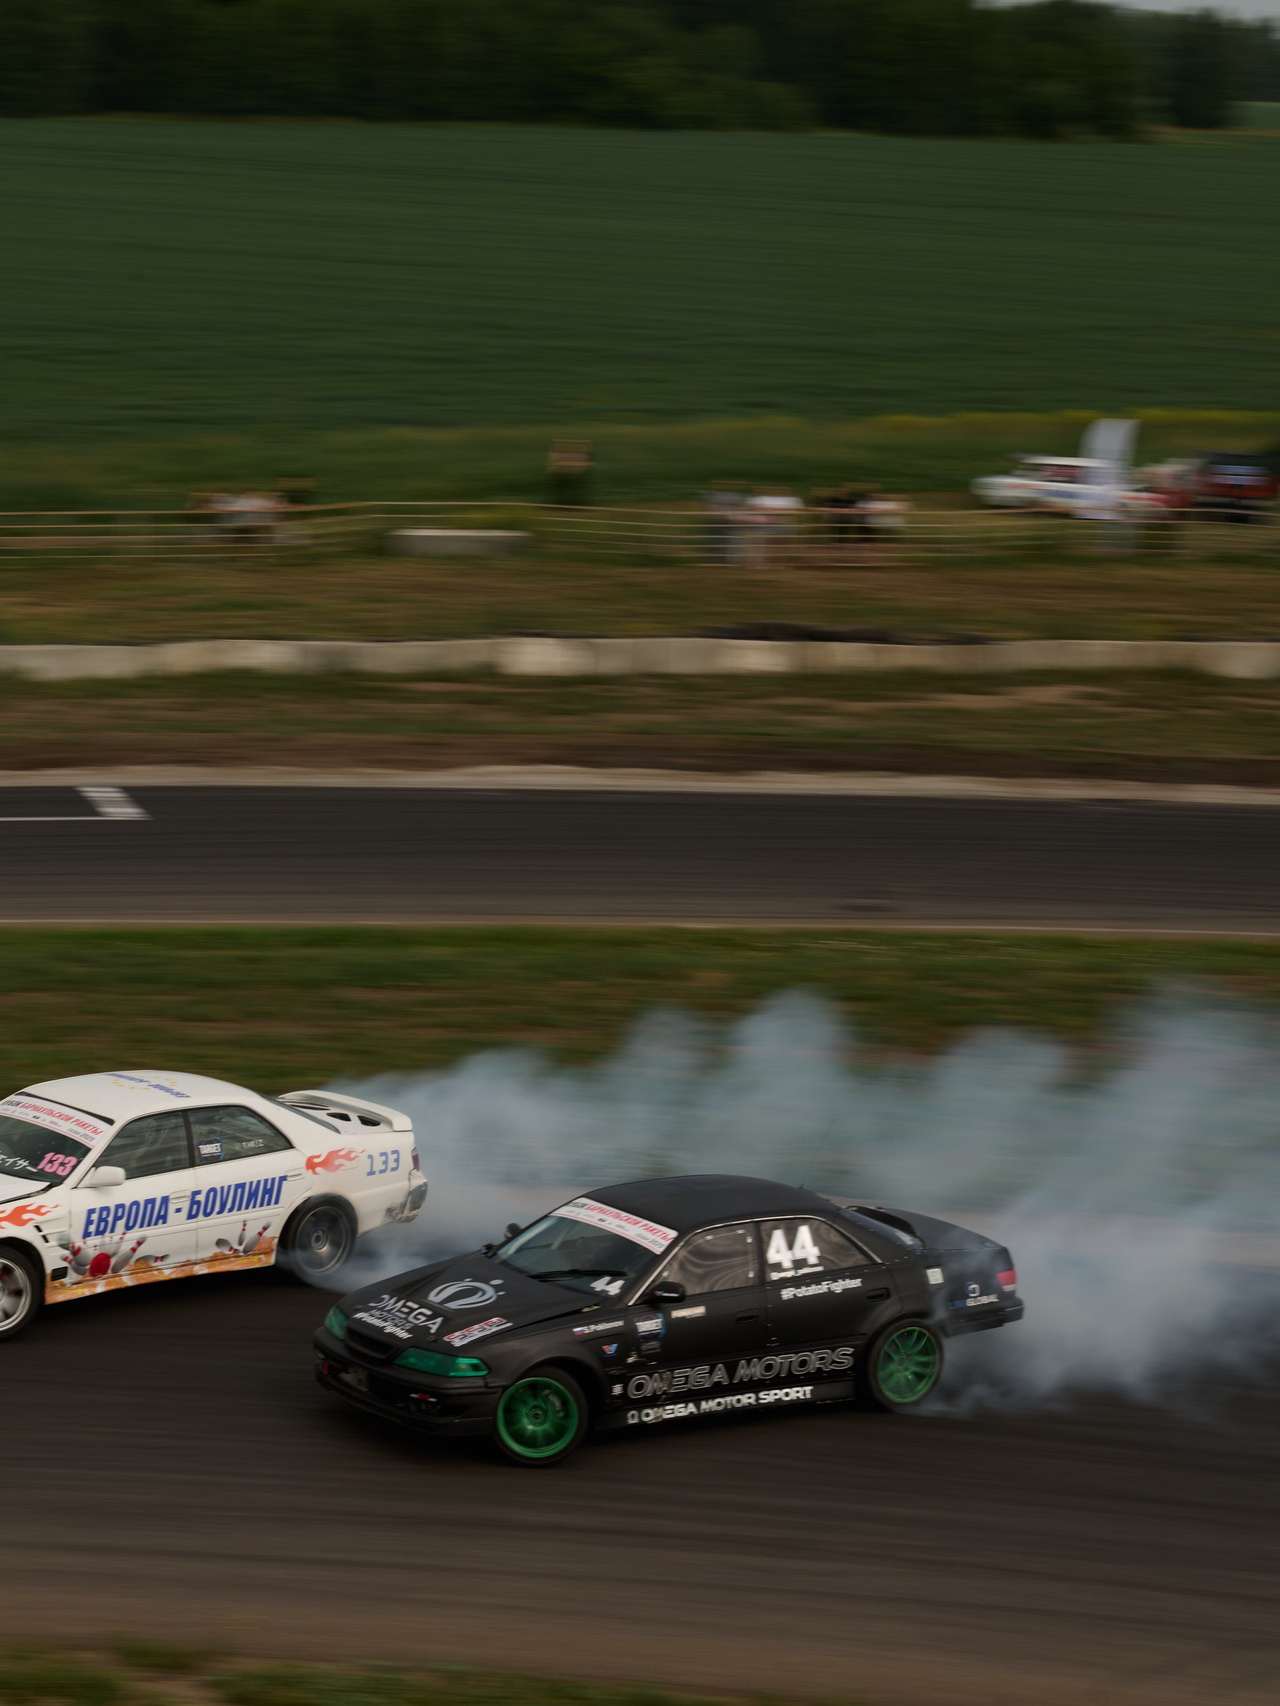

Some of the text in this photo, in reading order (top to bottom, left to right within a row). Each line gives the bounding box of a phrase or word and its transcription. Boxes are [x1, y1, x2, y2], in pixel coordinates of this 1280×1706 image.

[37, 1151, 78, 1176] 133
[366, 1149, 400, 1177] 133
[82, 1195, 170, 1239] ЕВРОПА
[186, 1175, 288, 1221] БОУЛИНГ
[766, 1224, 821, 1269] 44
[589, 1276, 626, 1296] 44
[780, 1278, 863, 1300] #PotatoFighter
[627, 1347, 855, 1399] OMEGA MOTORS
[641, 1386, 814, 1424] OMEGA MOTOR SPORT
